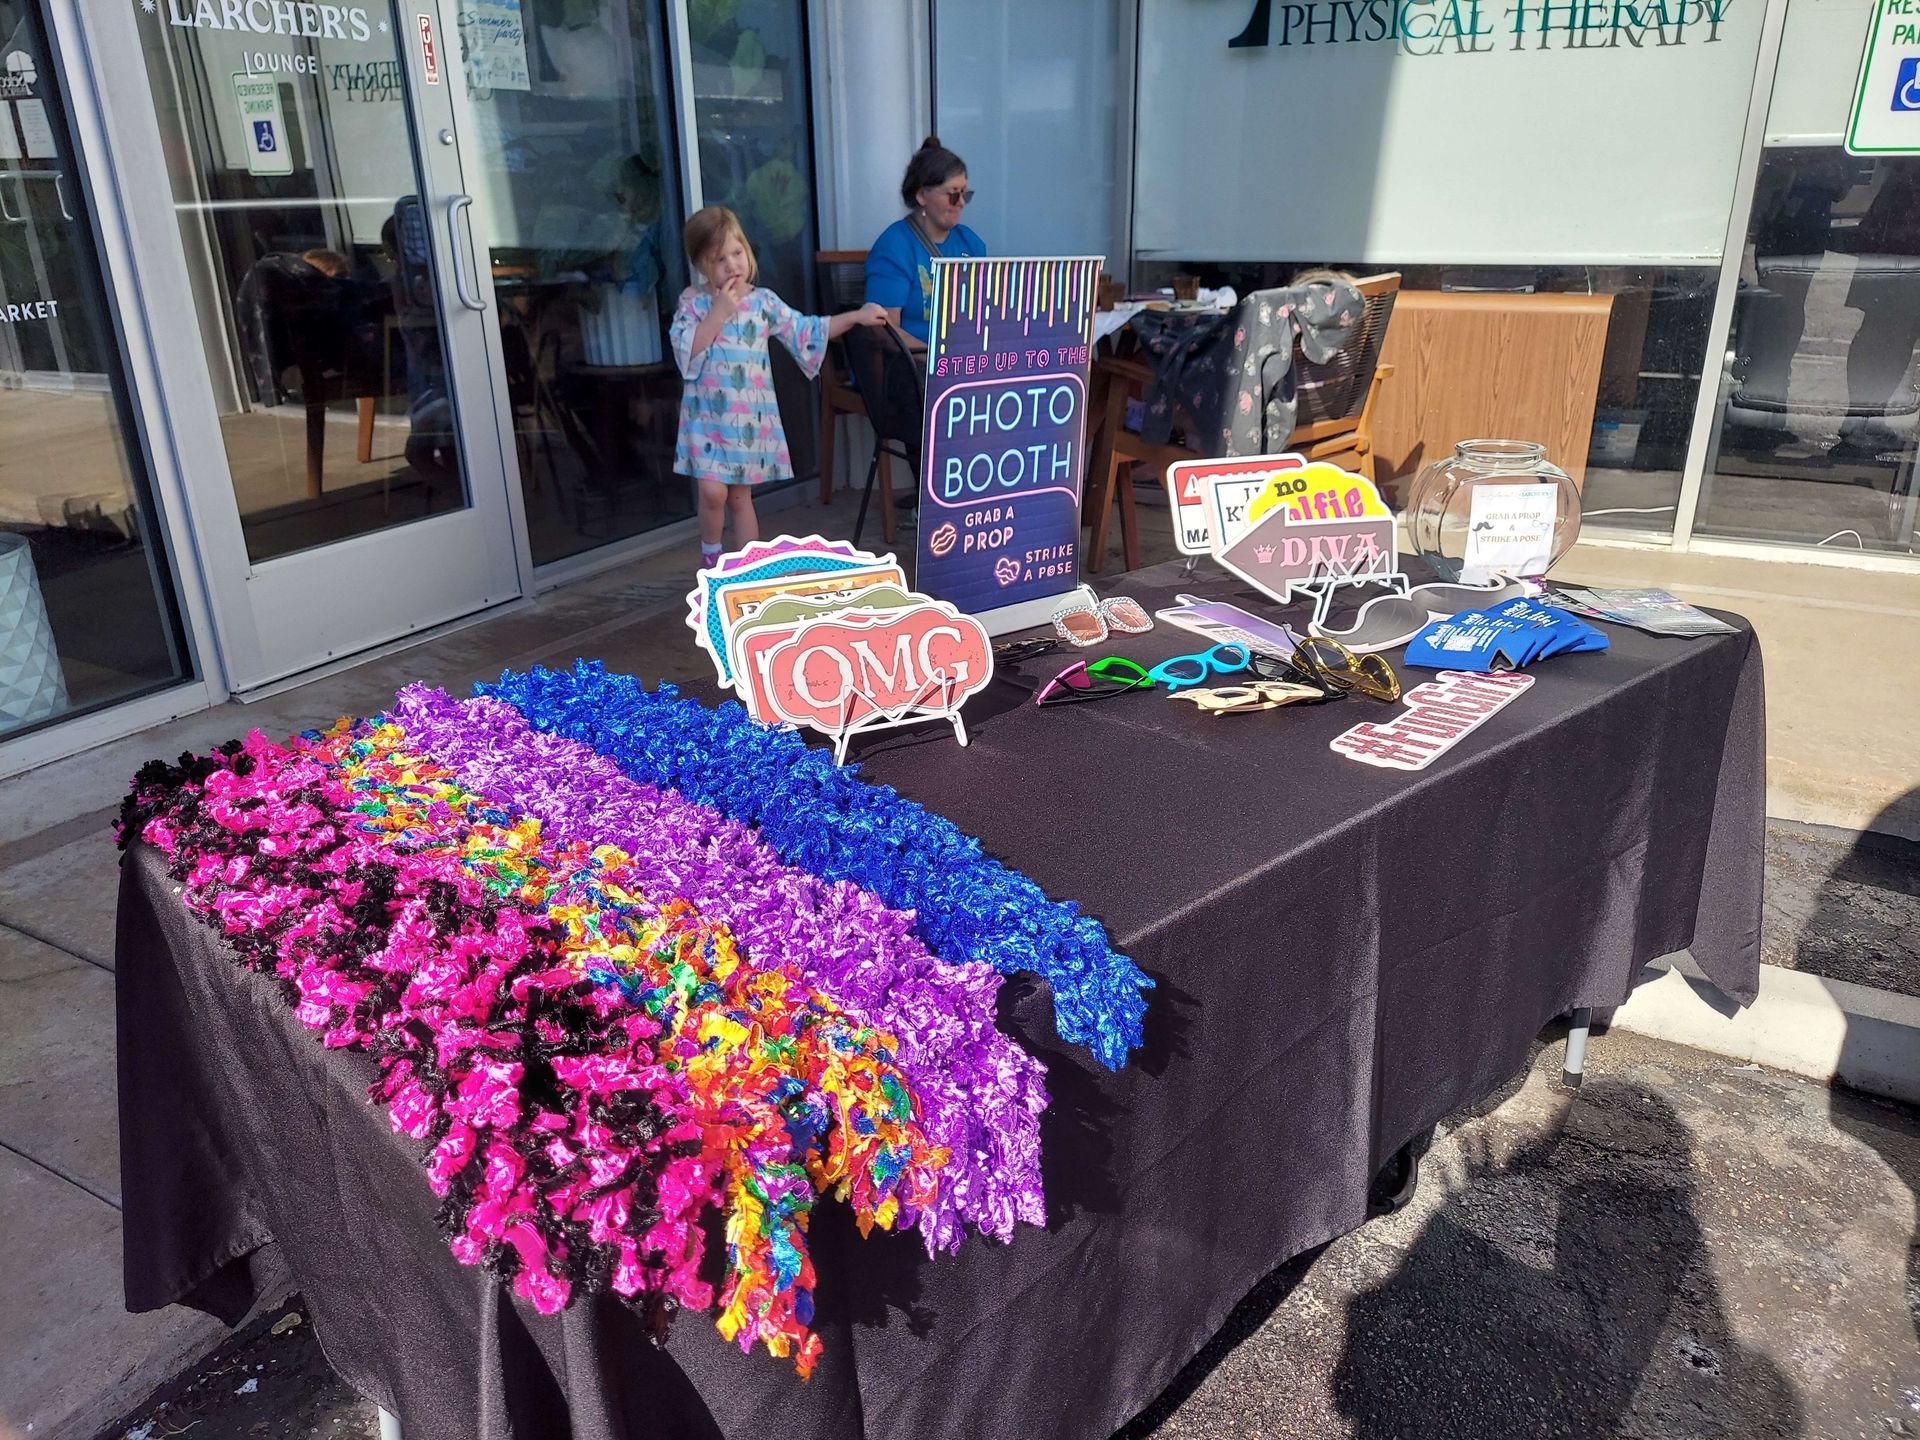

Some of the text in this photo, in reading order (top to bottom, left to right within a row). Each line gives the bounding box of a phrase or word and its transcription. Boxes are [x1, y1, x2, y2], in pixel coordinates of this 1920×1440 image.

[170, 0, 371, 42] LARCHER'S
[1278, 0, 1494, 45] PHYSICAL
[420, 17, 435, 70] PULL
[243, 51, 318, 79] LOUNGE
[936, 346, 1088, 377] STEP UP TO THE
[947, 385, 1075, 438] PHOTO
[944, 441, 1073, 498] BOOTH
[1273, 478, 1307, 497] no
[964, 505, 1015, 528] GRAB A
[1486, 513, 1510, 521] GRAB
[1518, 512, 1541, 520] PROP
[963, 526, 1014, 553] PROP
[1279, 533, 1380, 567] DIVA
[1480, 535, 1511, 543] STRIKE
[1025, 543, 1074, 565] STRIKE
[1024, 561, 1073, 581] A POSE
[791, 625, 969, 709] OMG
